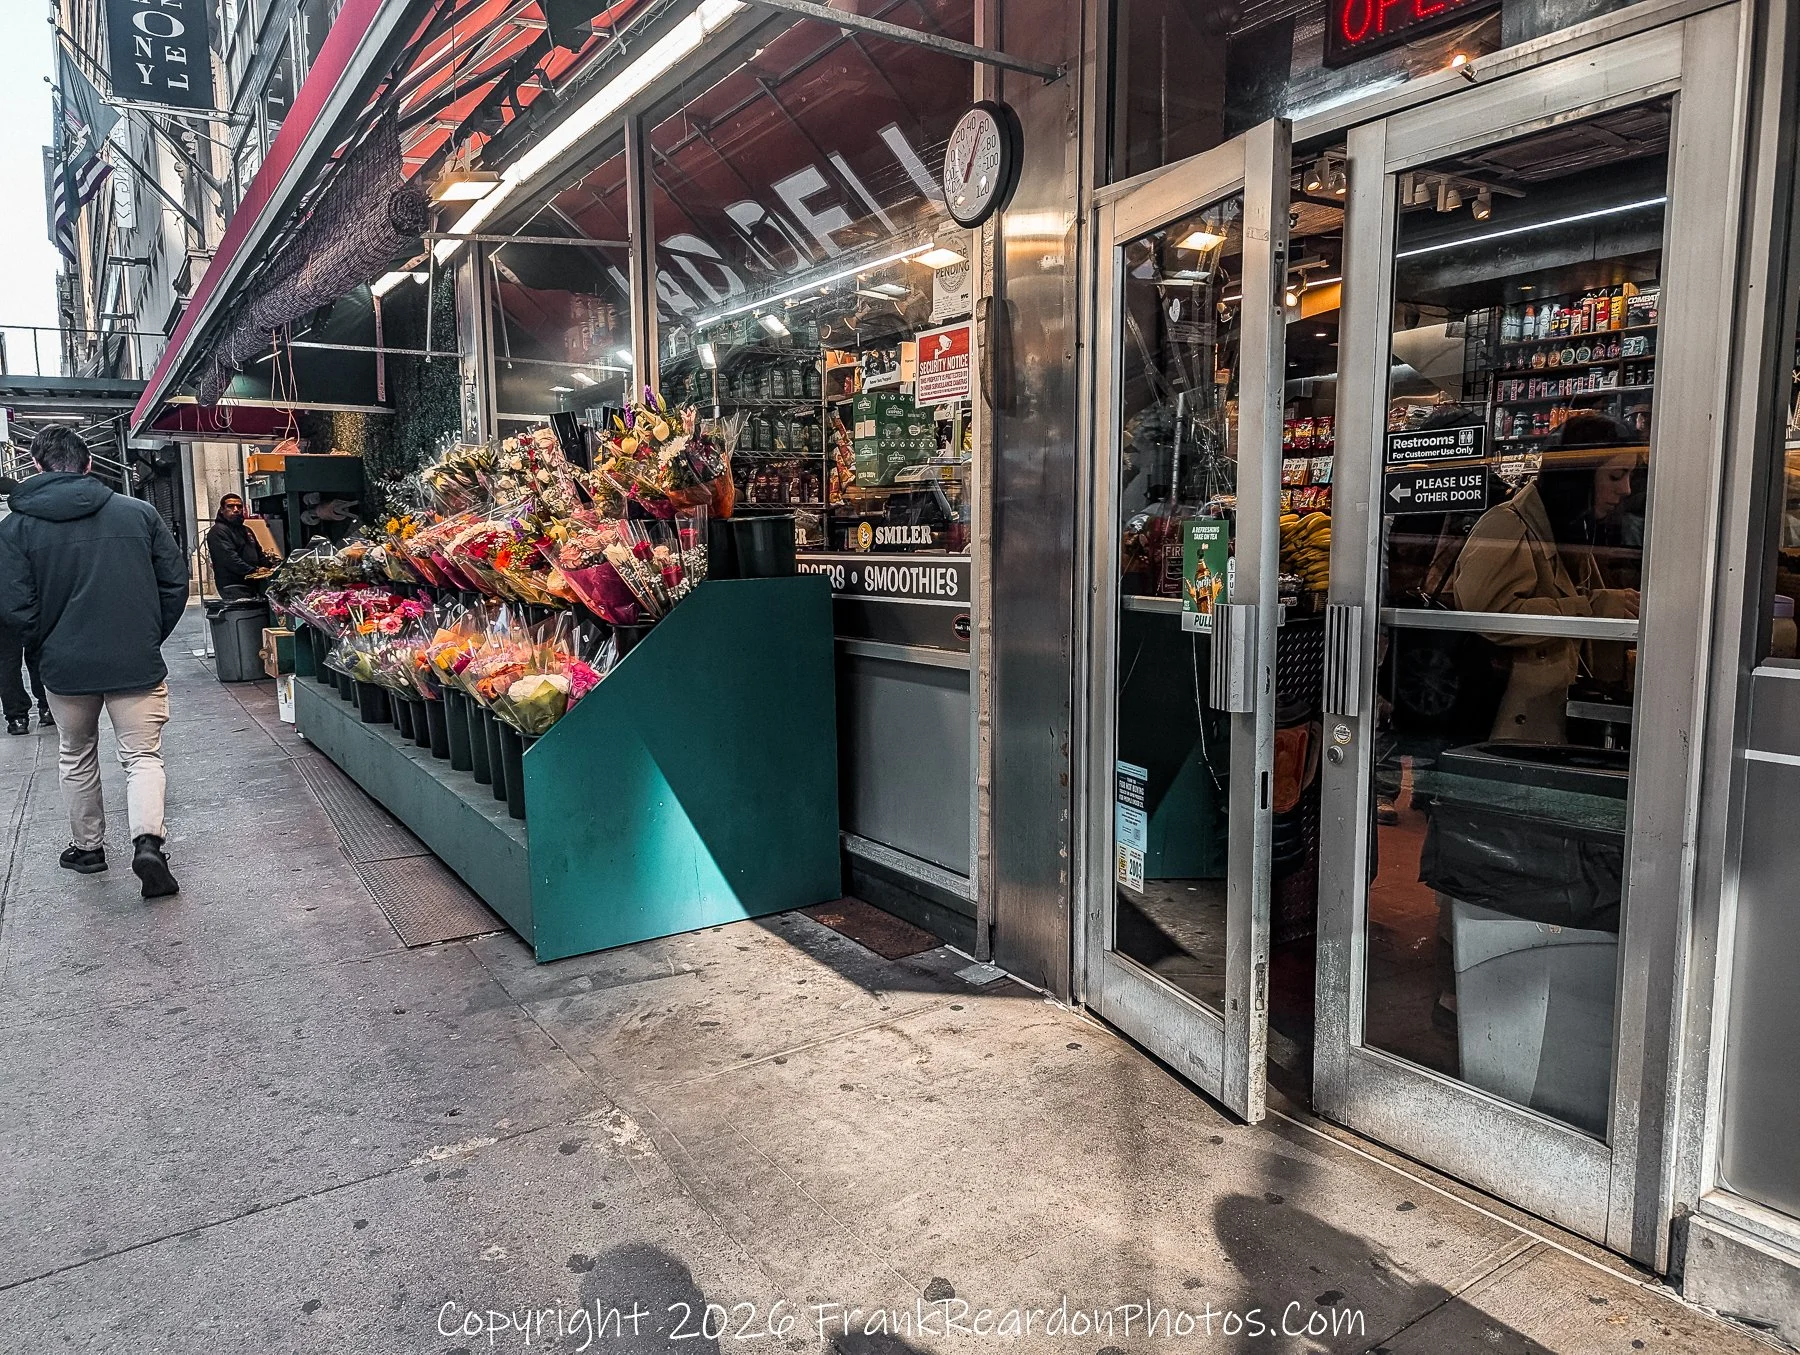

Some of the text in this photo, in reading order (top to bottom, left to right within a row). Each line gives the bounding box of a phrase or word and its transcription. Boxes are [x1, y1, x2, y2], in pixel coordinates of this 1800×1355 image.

[956, 127, 965, 144] 20
[986, 134, 996, 150] 80
[935, 259, 970, 279] PENDING
[919, 353, 969, 376] SECURITY NOTICE
[1393, 435, 1455, 450] Restrooms
[1392, 446, 1474, 460] For Customer Use Only
[1415, 475, 1482, 490] PLEASE USE
[1414, 489, 1482, 503] OTHER DOOR
[875, 525, 932, 545] SMILER
[864, 565, 958, 597] SMOOTHIES
[1195, 575, 1212, 591] Sprite
[1194, 614, 1213, 627] PULL
